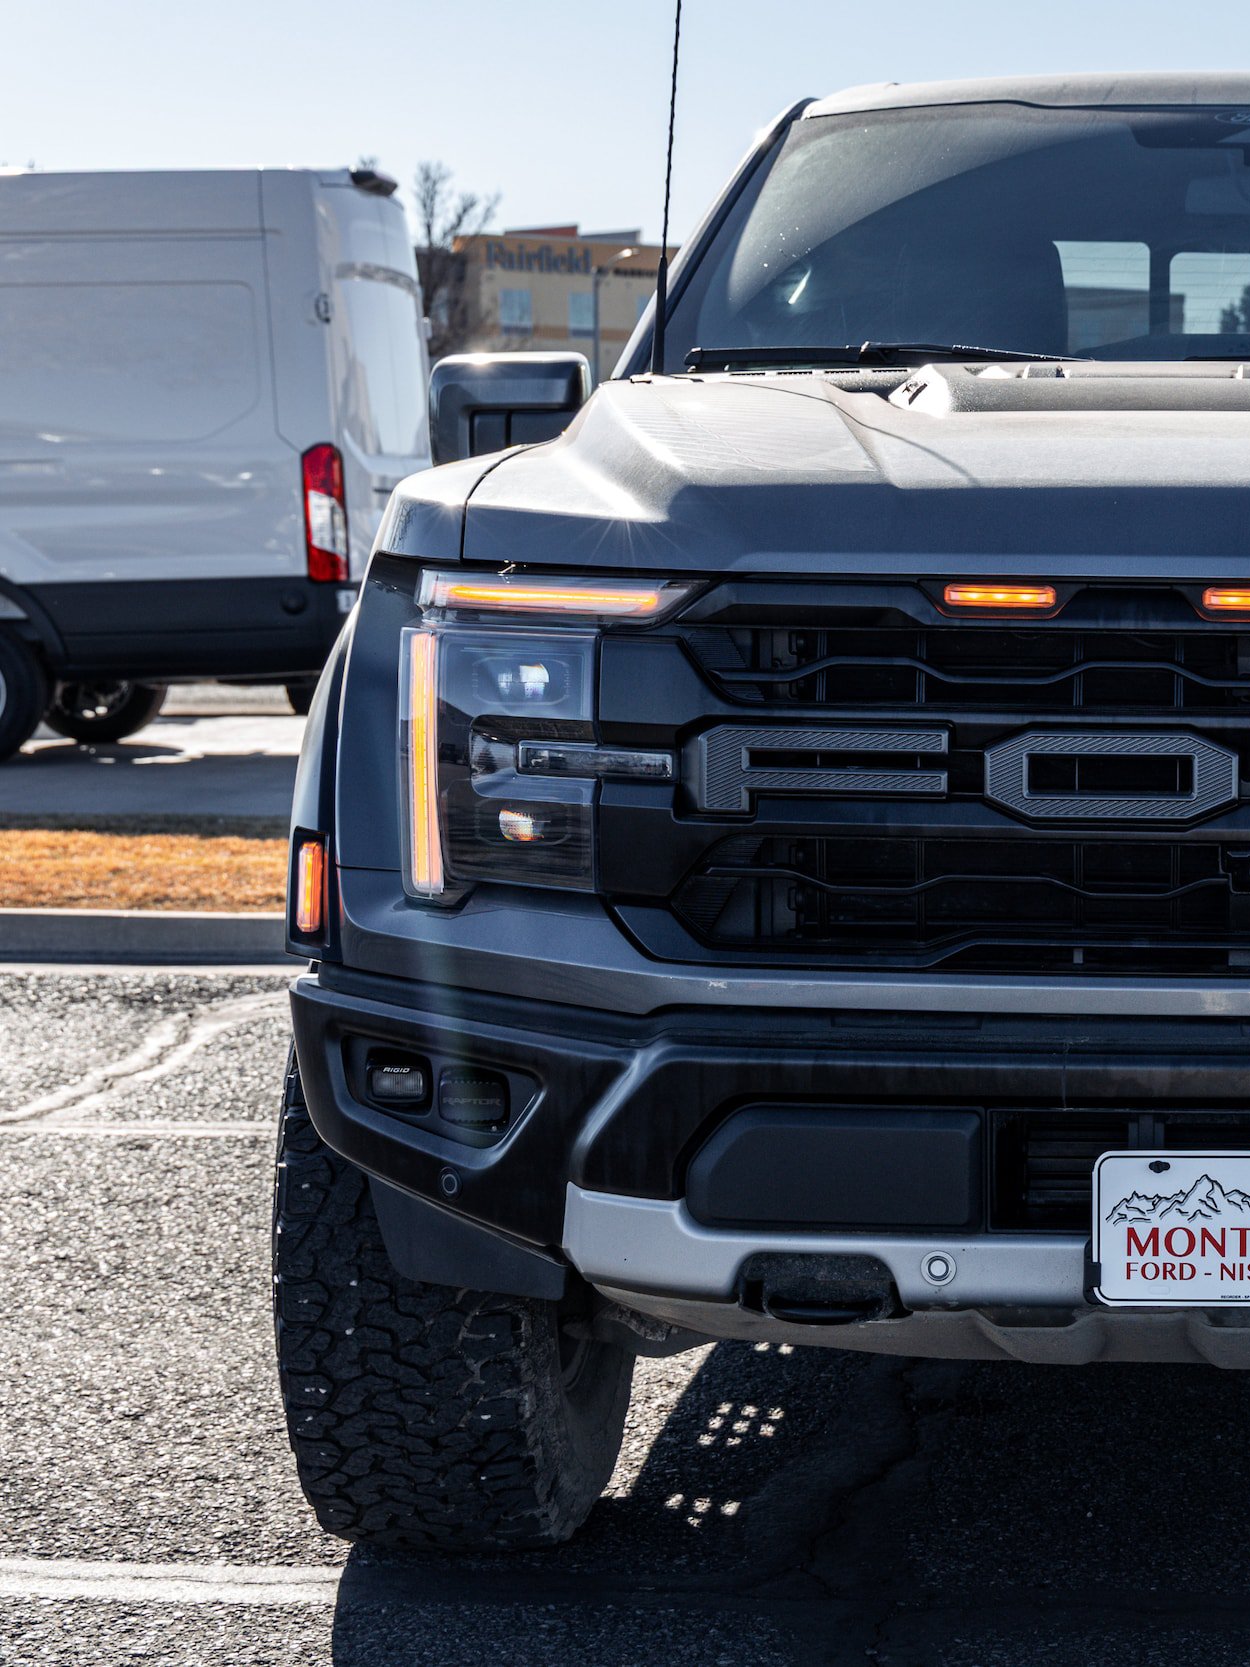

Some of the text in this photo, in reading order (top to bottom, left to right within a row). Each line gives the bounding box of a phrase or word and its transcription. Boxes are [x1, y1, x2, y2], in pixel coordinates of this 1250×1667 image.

[486, 240, 593, 273] Fairfield
[442, 1097, 501, 1106] RAPTOR
[1126, 1262, 1197, 1281] FORD
